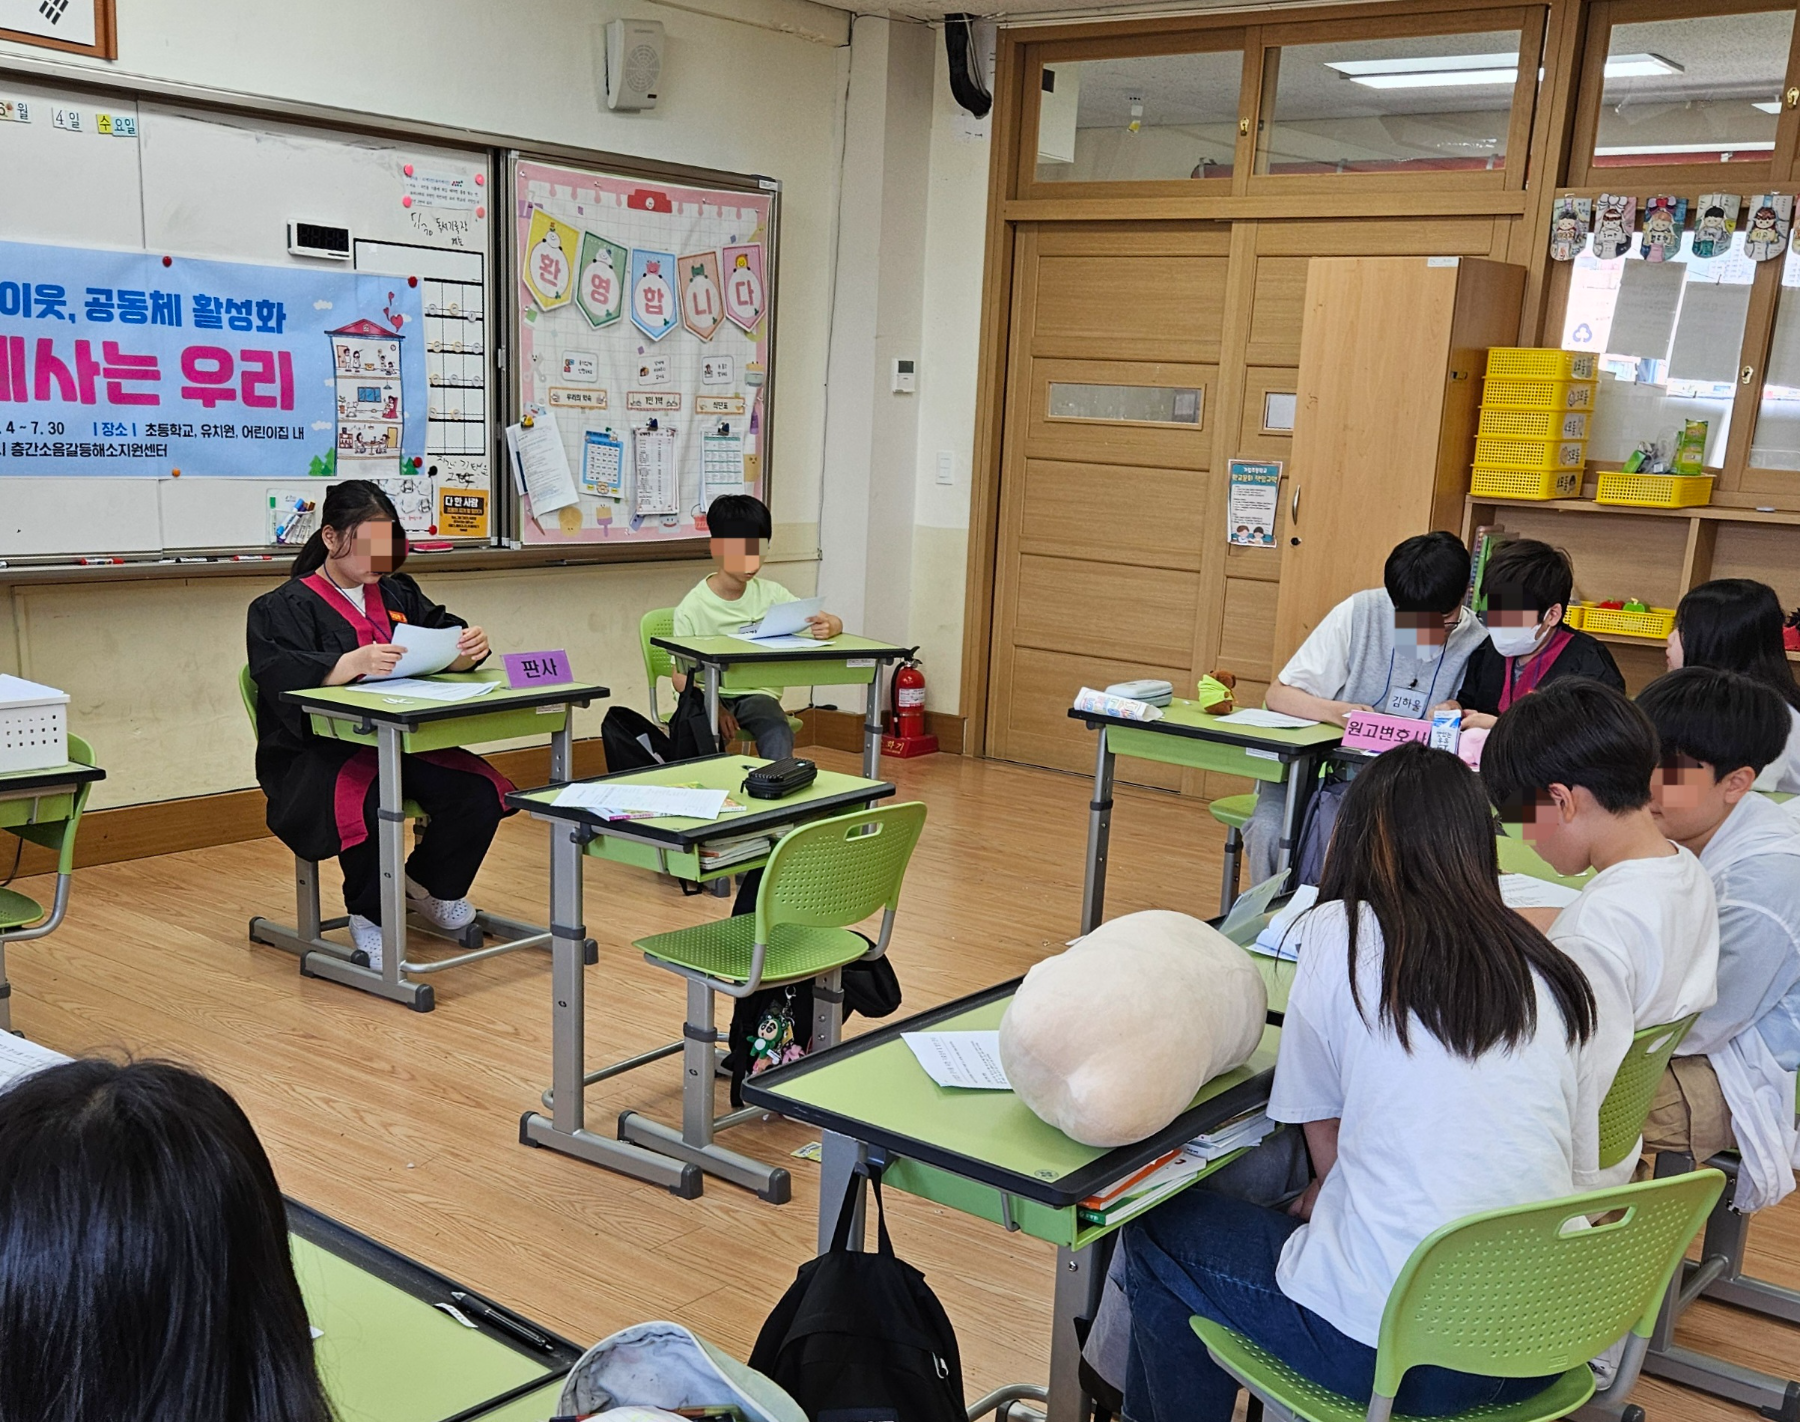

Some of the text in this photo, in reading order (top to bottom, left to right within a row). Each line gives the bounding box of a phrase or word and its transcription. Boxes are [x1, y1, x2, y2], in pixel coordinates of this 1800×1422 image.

[56, 110, 80, 128] 4일
[99, 115, 136, 135] 수요일
[538, 253, 756, 317] 환영합니다
[0, 281, 287, 334] 이웃, 공동체 활성화
[181, 345, 295, 411] 우리
[145, 423, 197, 438] 초등학교,
[201, 423, 239, 439] 유치원,
[242, 425, 289, 440] 어린이집
[292, 426, 304, 440] 내
[11, 441, 168, 458] 층간소음갈등해소지원센터
[521, 658, 558, 678] 판사
